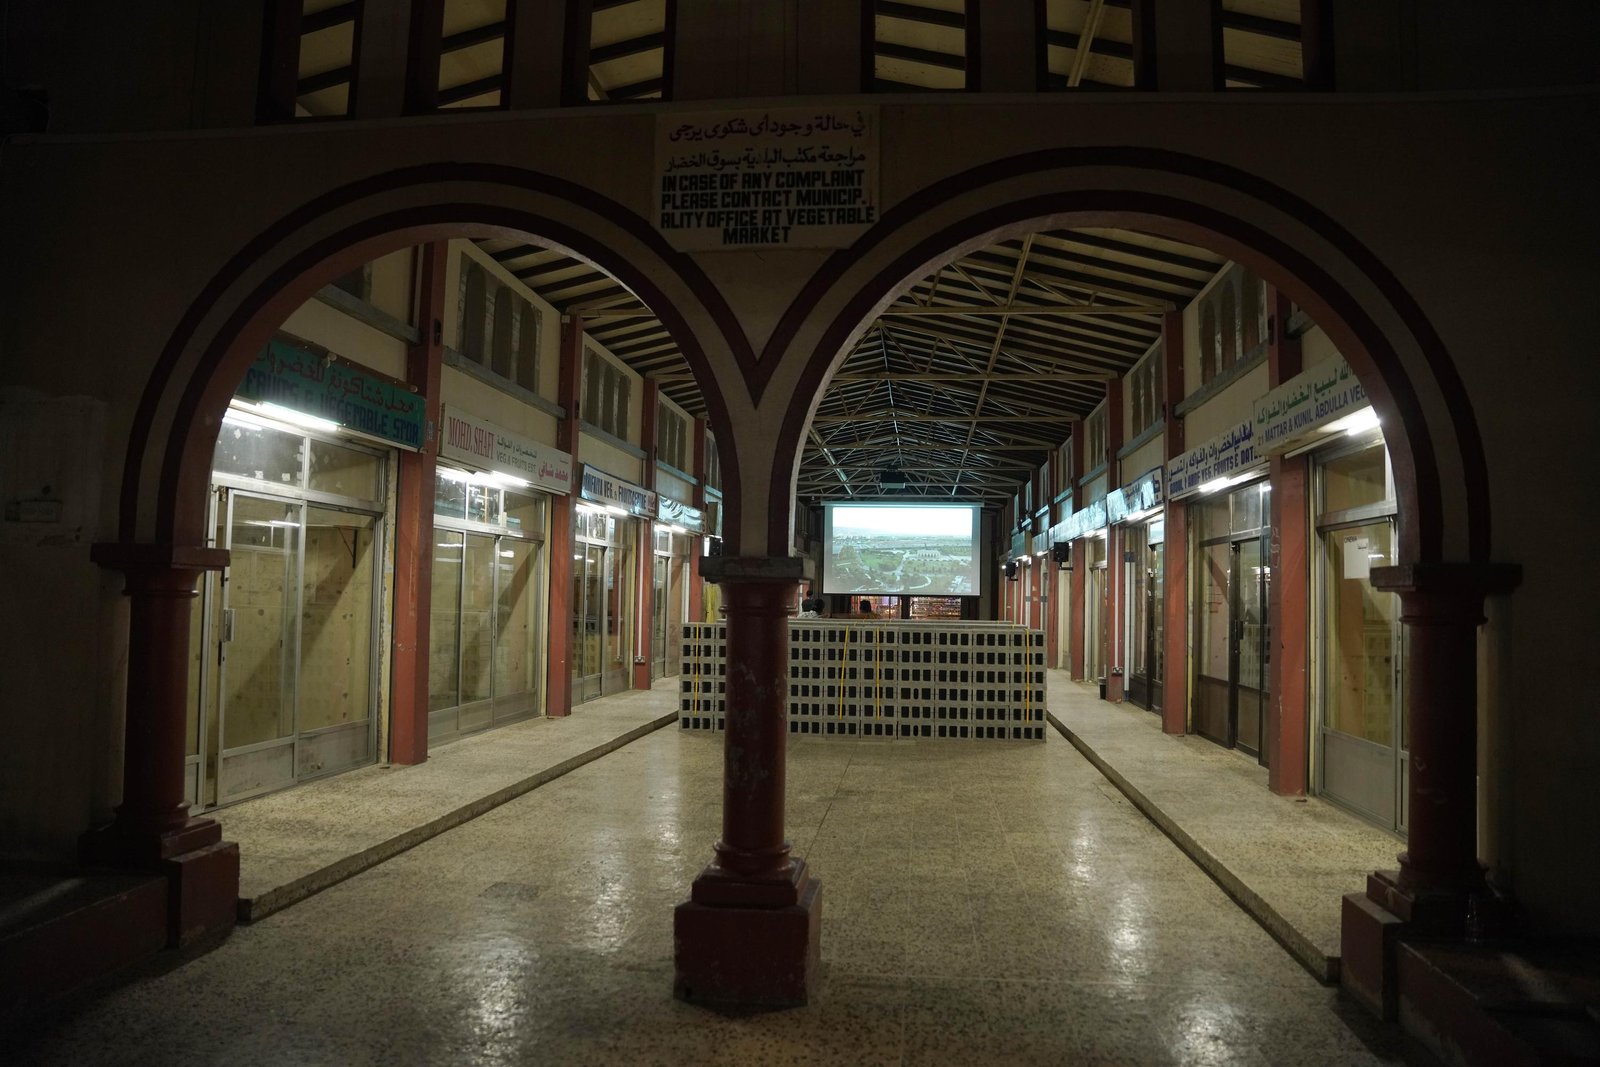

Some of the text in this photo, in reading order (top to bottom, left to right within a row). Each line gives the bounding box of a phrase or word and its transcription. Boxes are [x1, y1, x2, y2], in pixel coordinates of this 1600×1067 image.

[815, 115, 849, 131] حالة
[851, 111, 866, 137] في
[665, 146, 866, 172] مراجعة مكتب البلية بسوق الخضار
[662, 170, 865, 192] IN CASE OF ANY COMPLAINT
[661, 192, 719, 210] PLEASE
[721, 190, 791, 208] CONTACT
[661, 206, 875, 229] ALITY OFFICE AT VEGETABLE
[723, 226, 791, 245] MARKET
[385, 389, 415, 413] محل
[1315, 390, 1349, 420] ABDULLA
[1240, 446, 1263, 466] DAT
